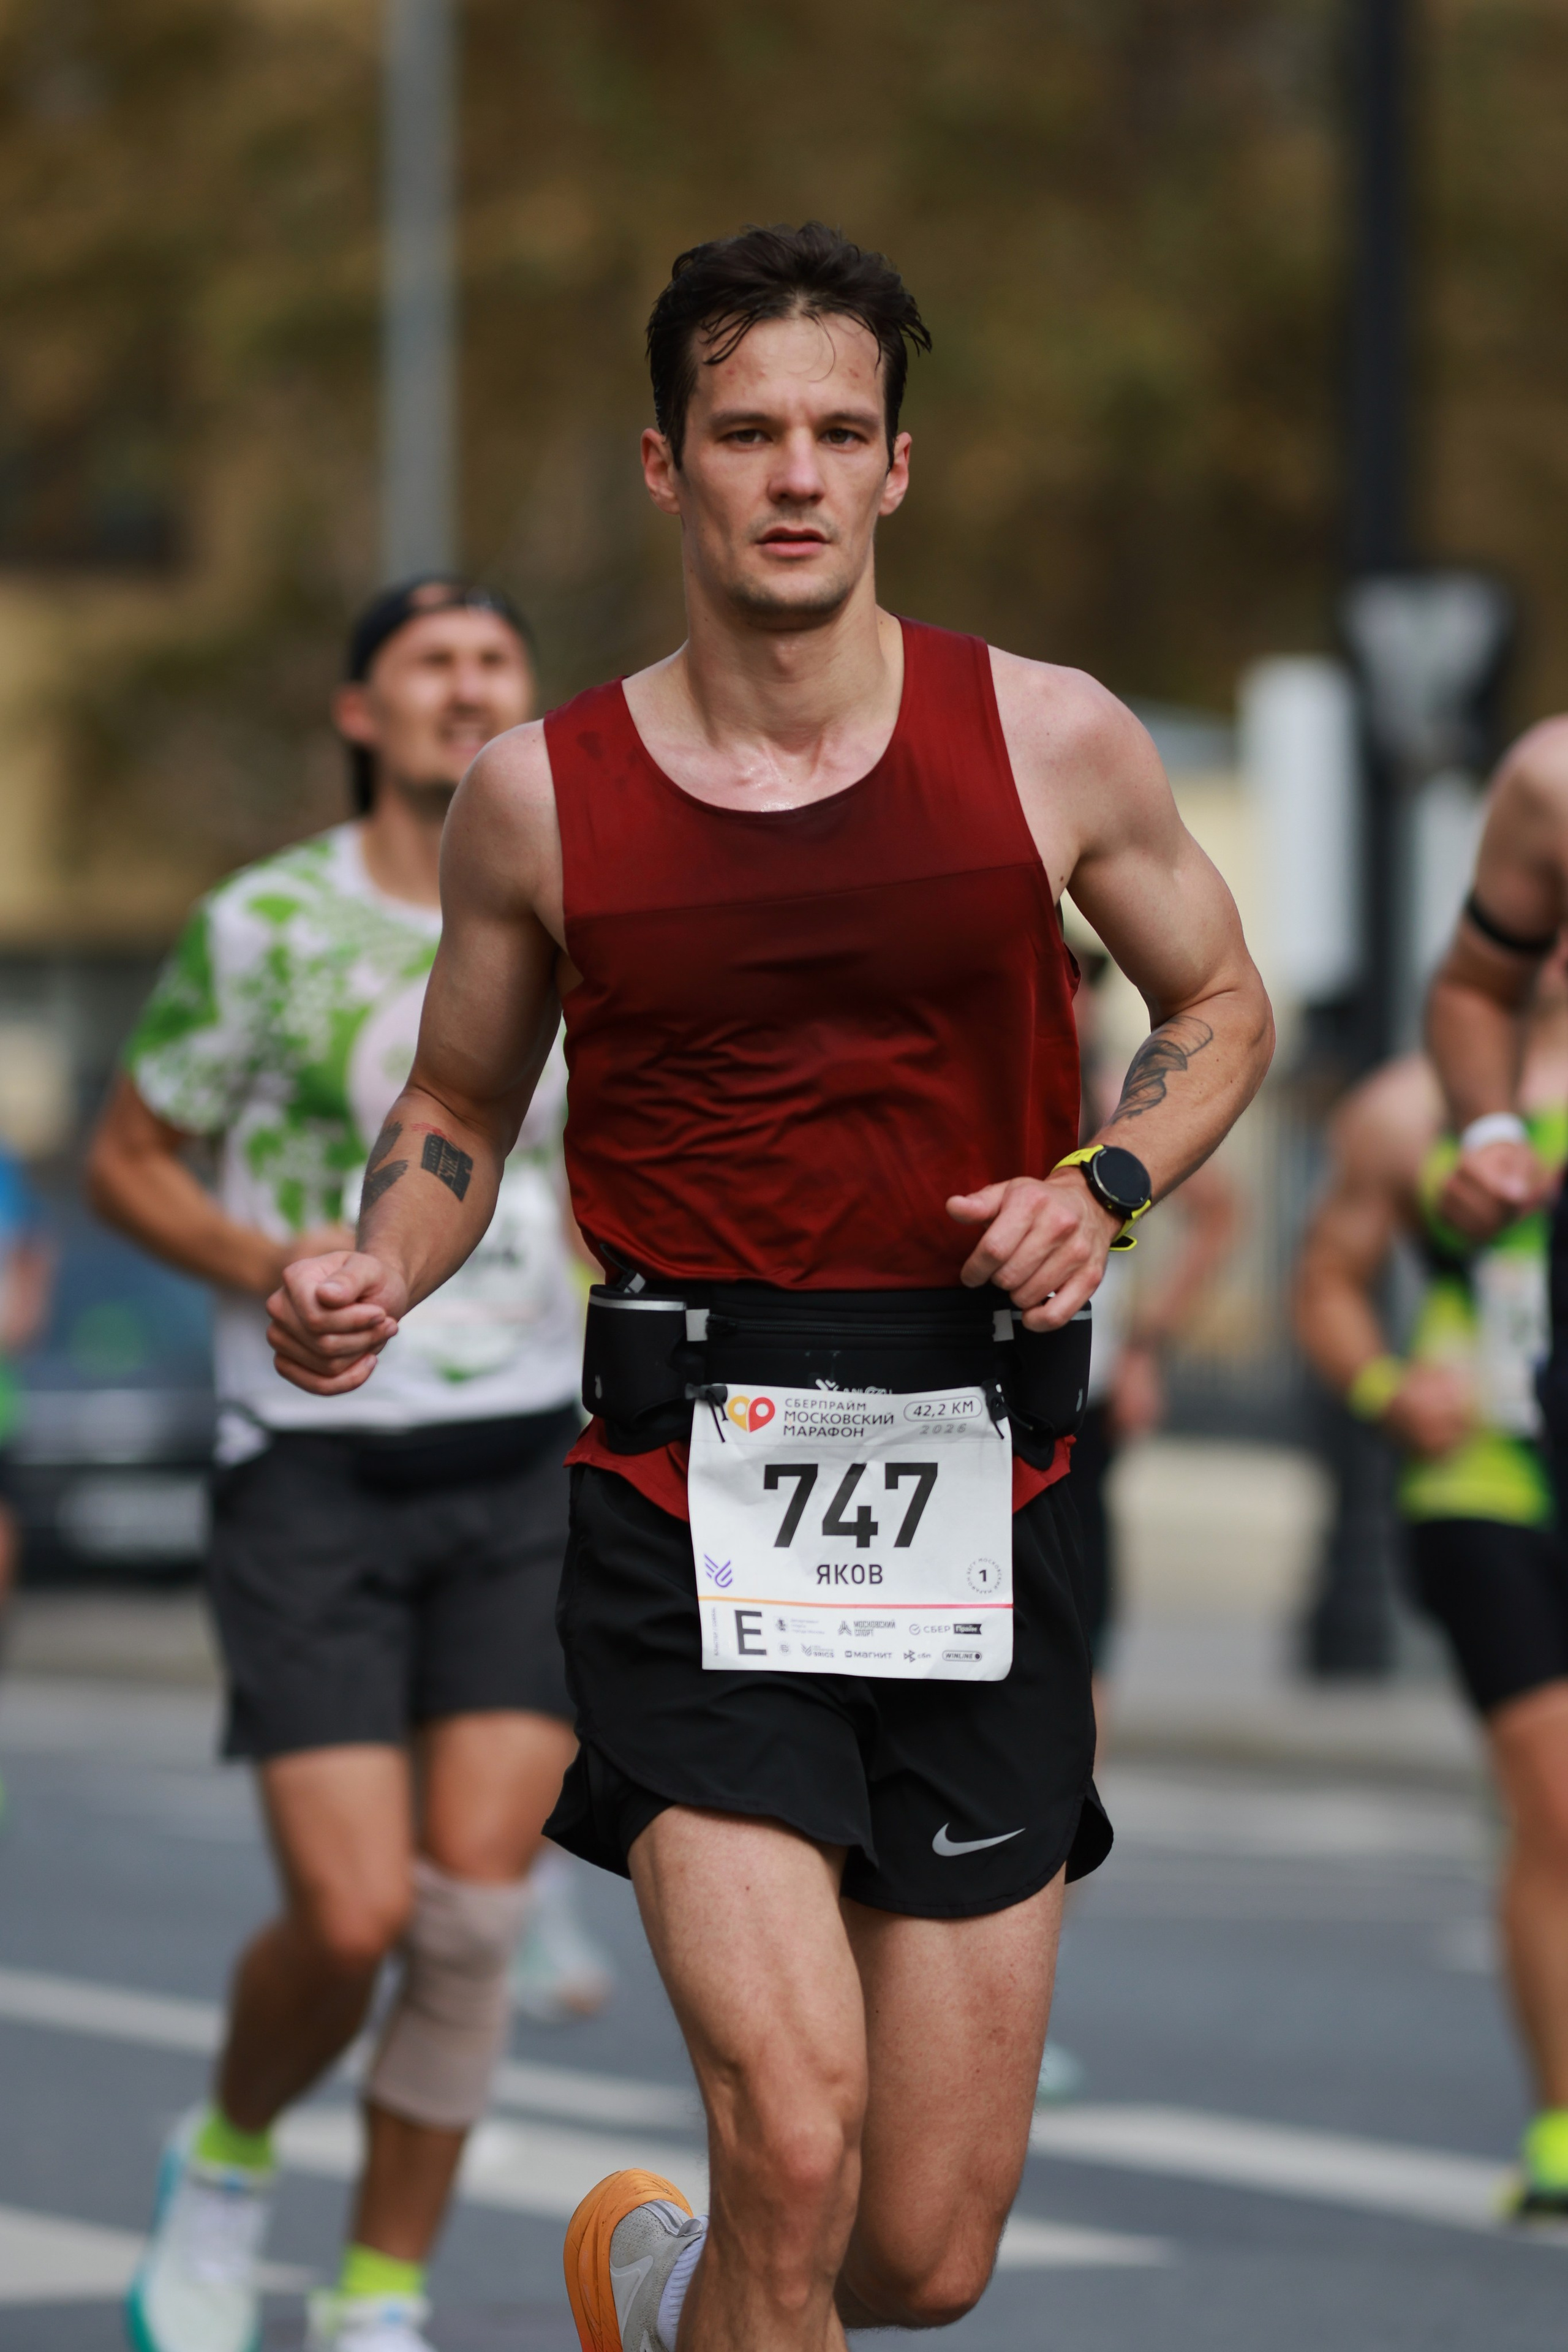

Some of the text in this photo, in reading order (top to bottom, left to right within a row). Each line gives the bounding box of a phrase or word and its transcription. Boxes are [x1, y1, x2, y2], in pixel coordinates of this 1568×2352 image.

[785, 1398, 867, 1411] СБЕРПРАЙМ
[913, 1403, 946, 1417] 42,2
[784, 1410, 895, 1425] МОСКОВСКИЙ
[783, 1424, 865, 1438] МАРАФОН
[919, 1423, 967, 1435] 2026
[763, 1462, 938, 1548] 747
[816, 1564, 884, 1586] ЯКОВ
[979, 1569, 987, 1583] 1
[734, 1609, 767, 1656] E
